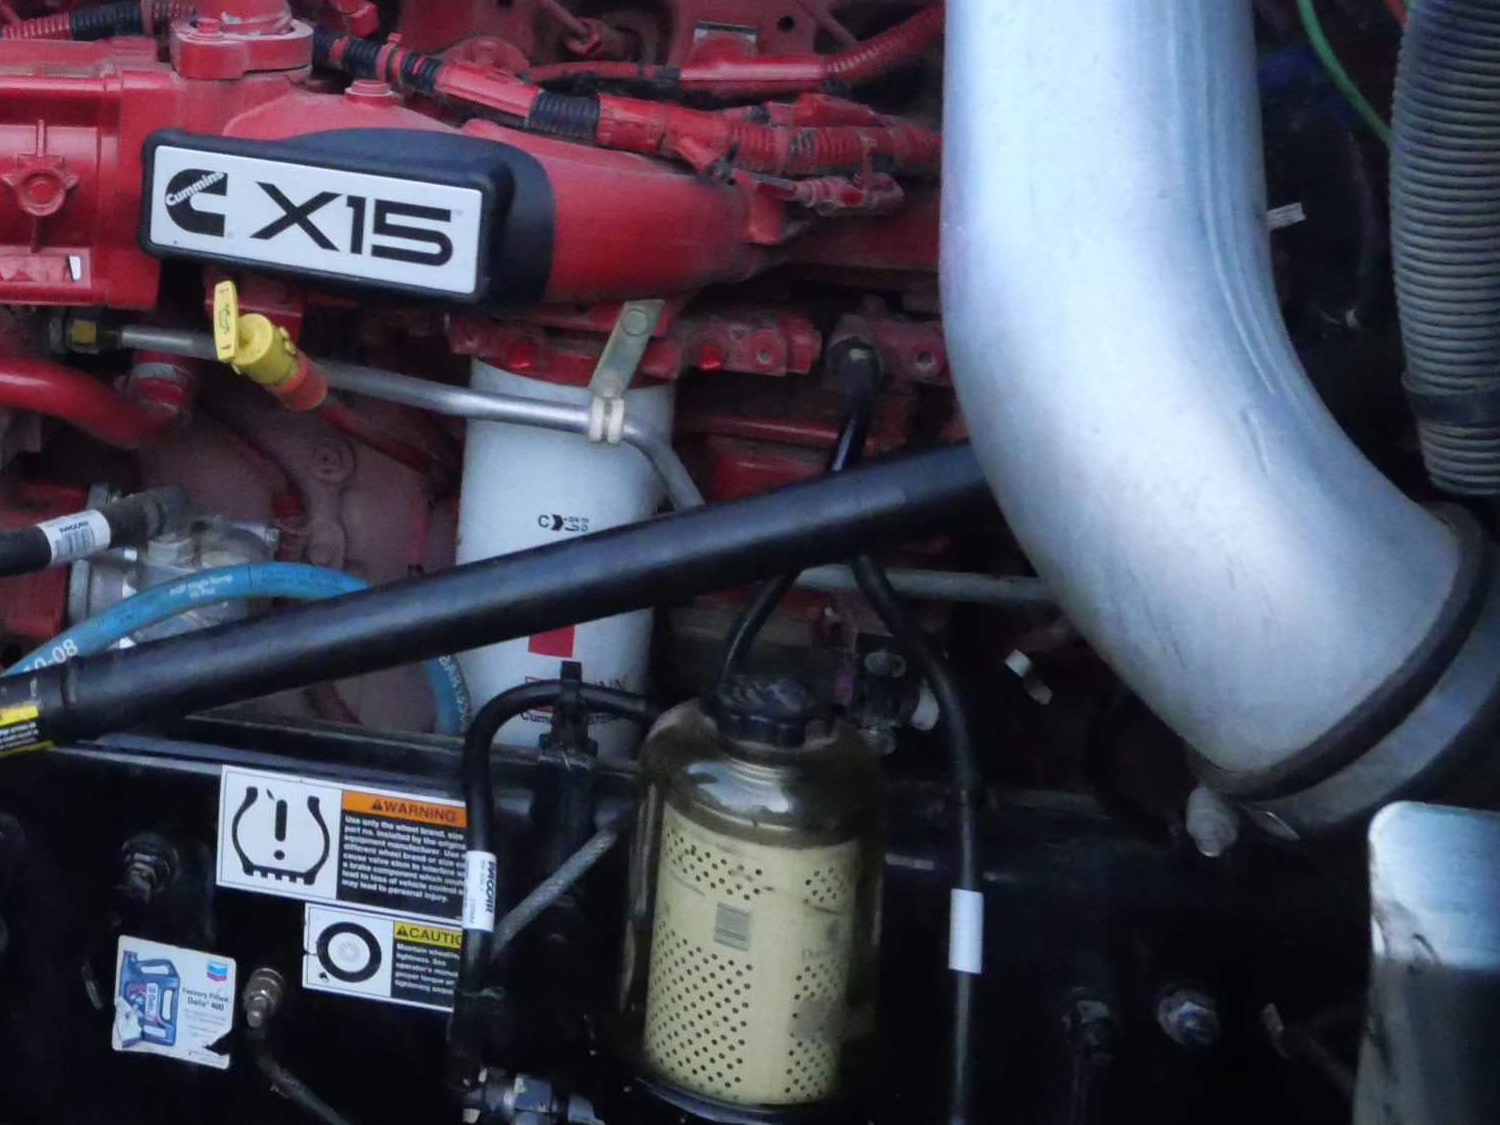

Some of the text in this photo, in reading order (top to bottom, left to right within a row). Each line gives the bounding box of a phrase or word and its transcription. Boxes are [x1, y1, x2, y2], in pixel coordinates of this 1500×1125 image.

[165, 171, 225, 206] Cummins
[250, 181, 454, 267] X15
[384, 800, 457, 823] WARNING
[345, 815, 361, 825] Use
[362, 819, 379, 829] only
[380, 821, 394, 830] the
[395, 824, 419, 834] wheel
[344, 825, 360, 834] part
[376, 830, 410, 842] installed
[411, 835, 422, 845] by
[423, 836, 436, 846] the
[343, 835, 386, 847] equipment
[443, 849, 460, 858] Use
[343, 843, 377, 855] different
[378, 849, 402, 859] wheel
[402, 852, 427, 863] brand
[343, 853, 367, 862] cause
[368, 857, 389, 866] valve
[341, 879, 359, 889] may
[360, 881, 377, 891] lead
[378, 884, 388, 892] to
[387, 887, 423, 898] personal
[342, 869, 359, 878] lead
[360, 872, 370, 880] to
[388, 877, 398, 885] of
[398, 879, 427, 890] vehicle
[419, 874, 443, 884] which
